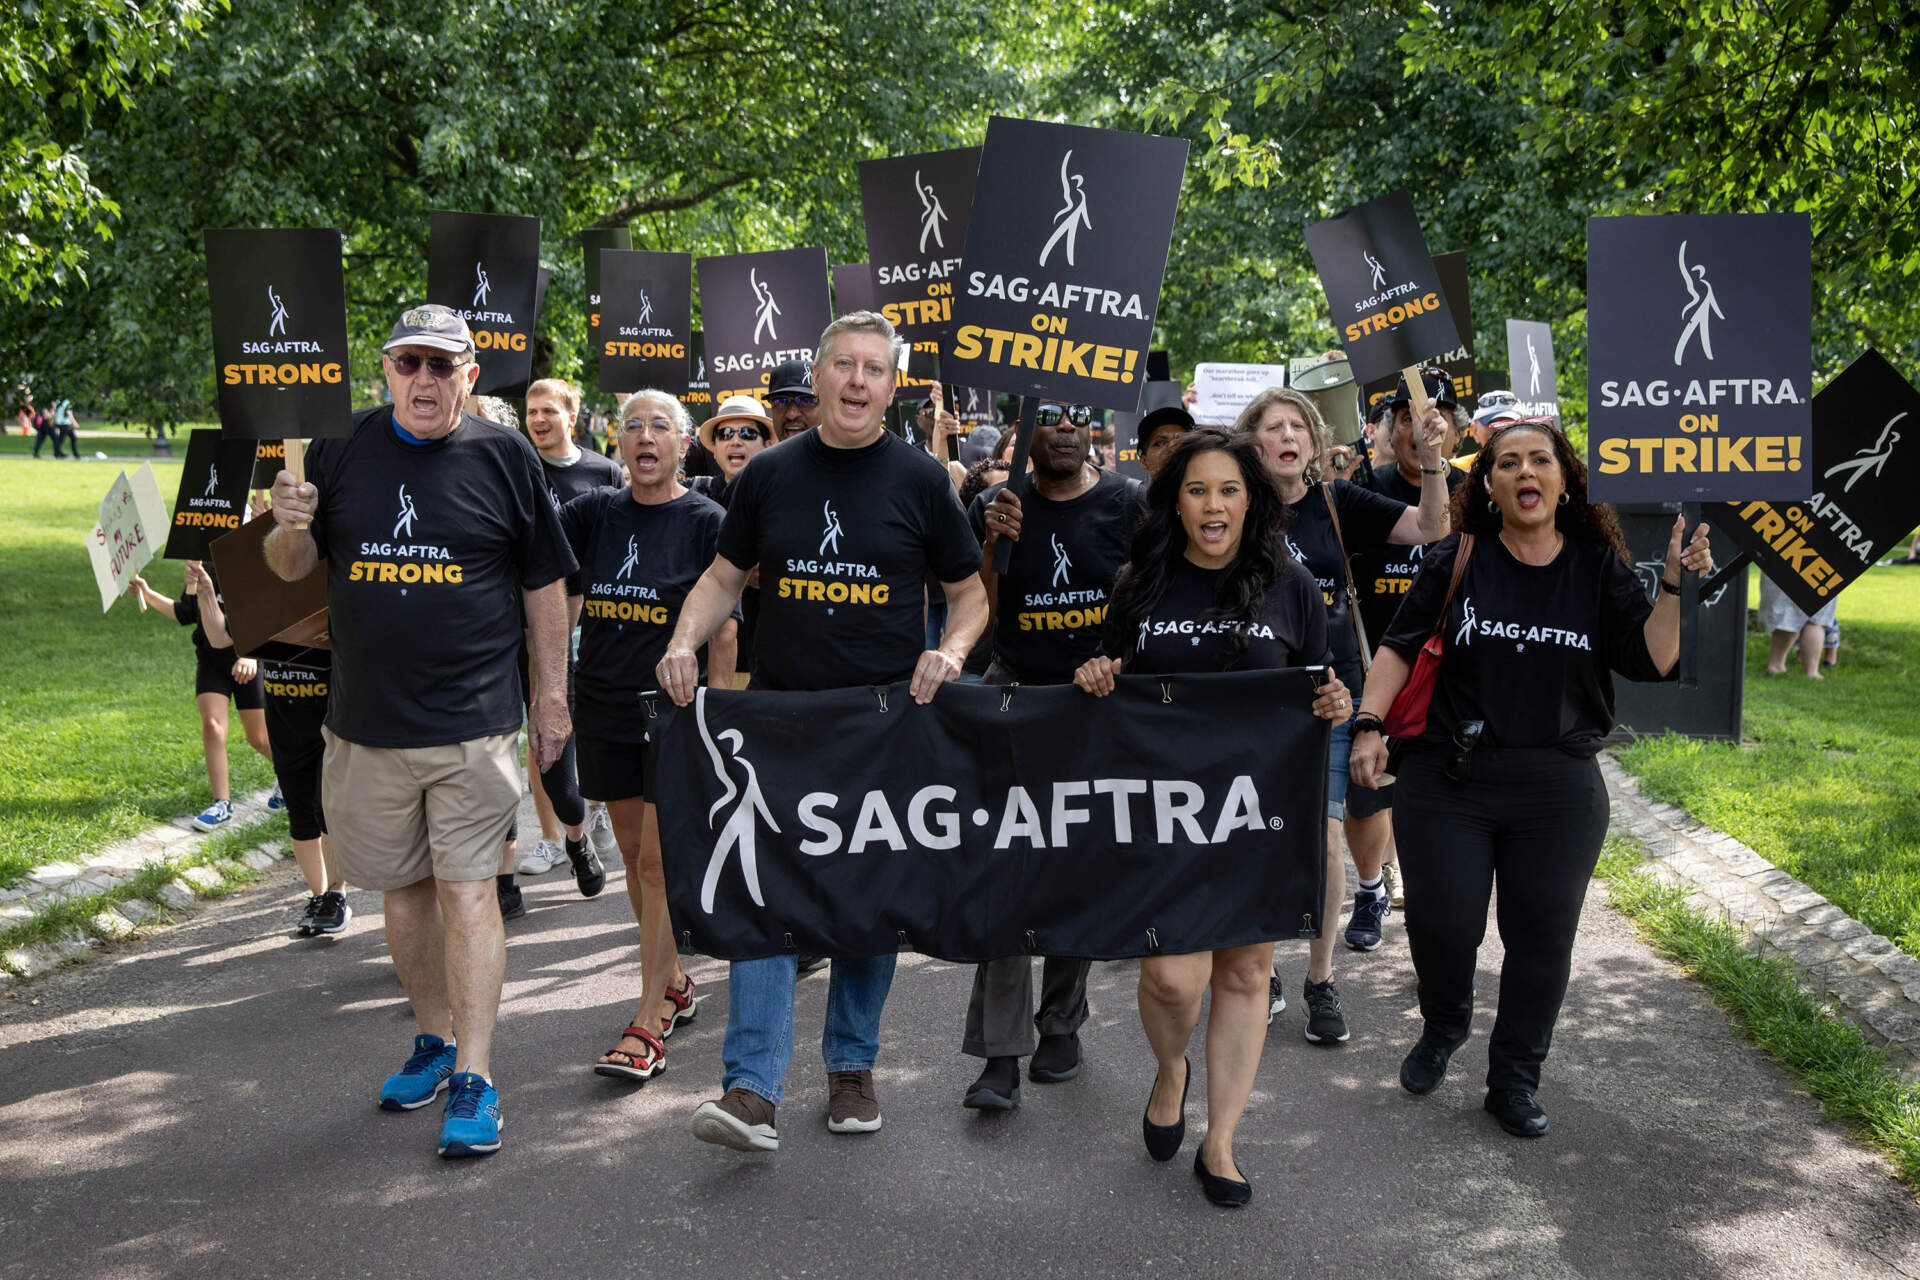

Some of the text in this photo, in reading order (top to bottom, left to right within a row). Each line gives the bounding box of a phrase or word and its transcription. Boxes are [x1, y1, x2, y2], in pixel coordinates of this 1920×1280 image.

[927, 282, 953, 297] ON
[881, 297, 956, 327] STRI
[1344, 292, 1441, 343] STRONG
[1031, 313, 1068, 335] ON
[470, 330, 527, 352] ONG
[605, 342, 684, 360] STRONG
[714, 348, 820, 373] SAG·AFTR
[953, 325, 1139, 384] STRIKE!
[224, 363, 341, 384] STRONG
[1680, 415, 1718, 432] ON
[1599, 437, 1801, 474] STRIKE!
[174, 511, 240, 529] STRONG
[1786, 506, 1815, 534] ON
[1726, 500, 1845, 597] TRIKE!
[350, 562, 462, 583] STRONG
[779, 576, 889, 603] STRONG
[586, 599, 667, 626] STRONG
[1018, 603, 1109, 631] STRON
[264, 669, 317, 681] AG·AFTRA
[263, 680, 329, 699] TRONG
